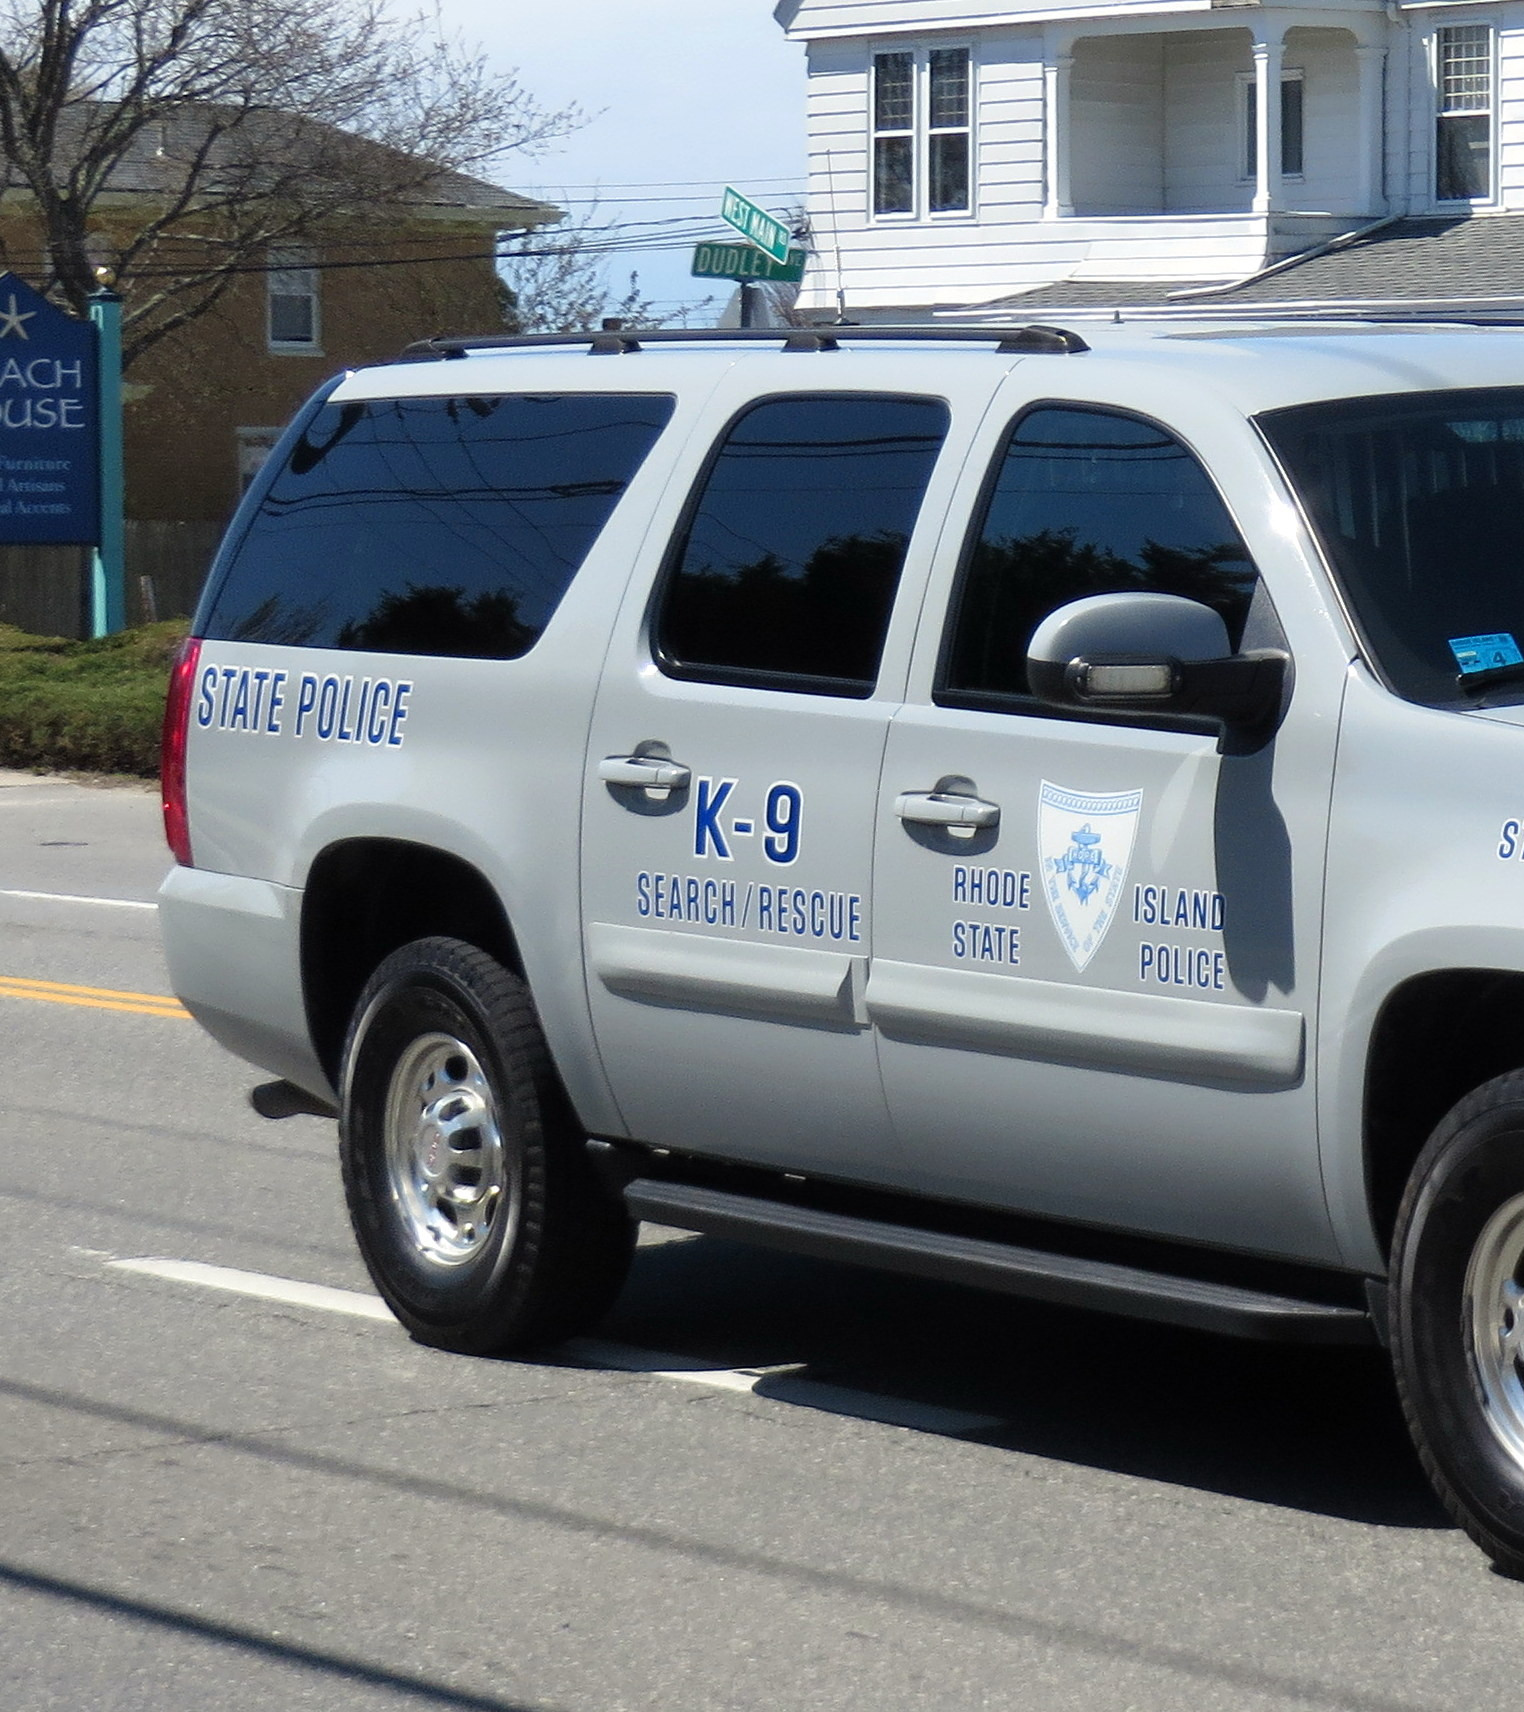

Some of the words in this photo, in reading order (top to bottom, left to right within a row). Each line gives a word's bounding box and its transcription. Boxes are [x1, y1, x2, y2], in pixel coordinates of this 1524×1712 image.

[724, 191, 751, 230] WEST
[749, 211, 777, 250] MAIN
[696, 246, 774, 277] DUDLEY
[0, 398, 86, 428] USE
[197, 663, 289, 736] STATE
[294, 671, 414, 748] POLICE
[693, 775, 804, 867] K-9
[636, 870, 862, 943] SEARCH/RESCUE
[952, 864, 1031, 911] RHODE
[1132, 883, 1228, 932] ISLAND
[952, 920, 1020, 965] STATE
[1138, 942, 1225, 991] POLICE
